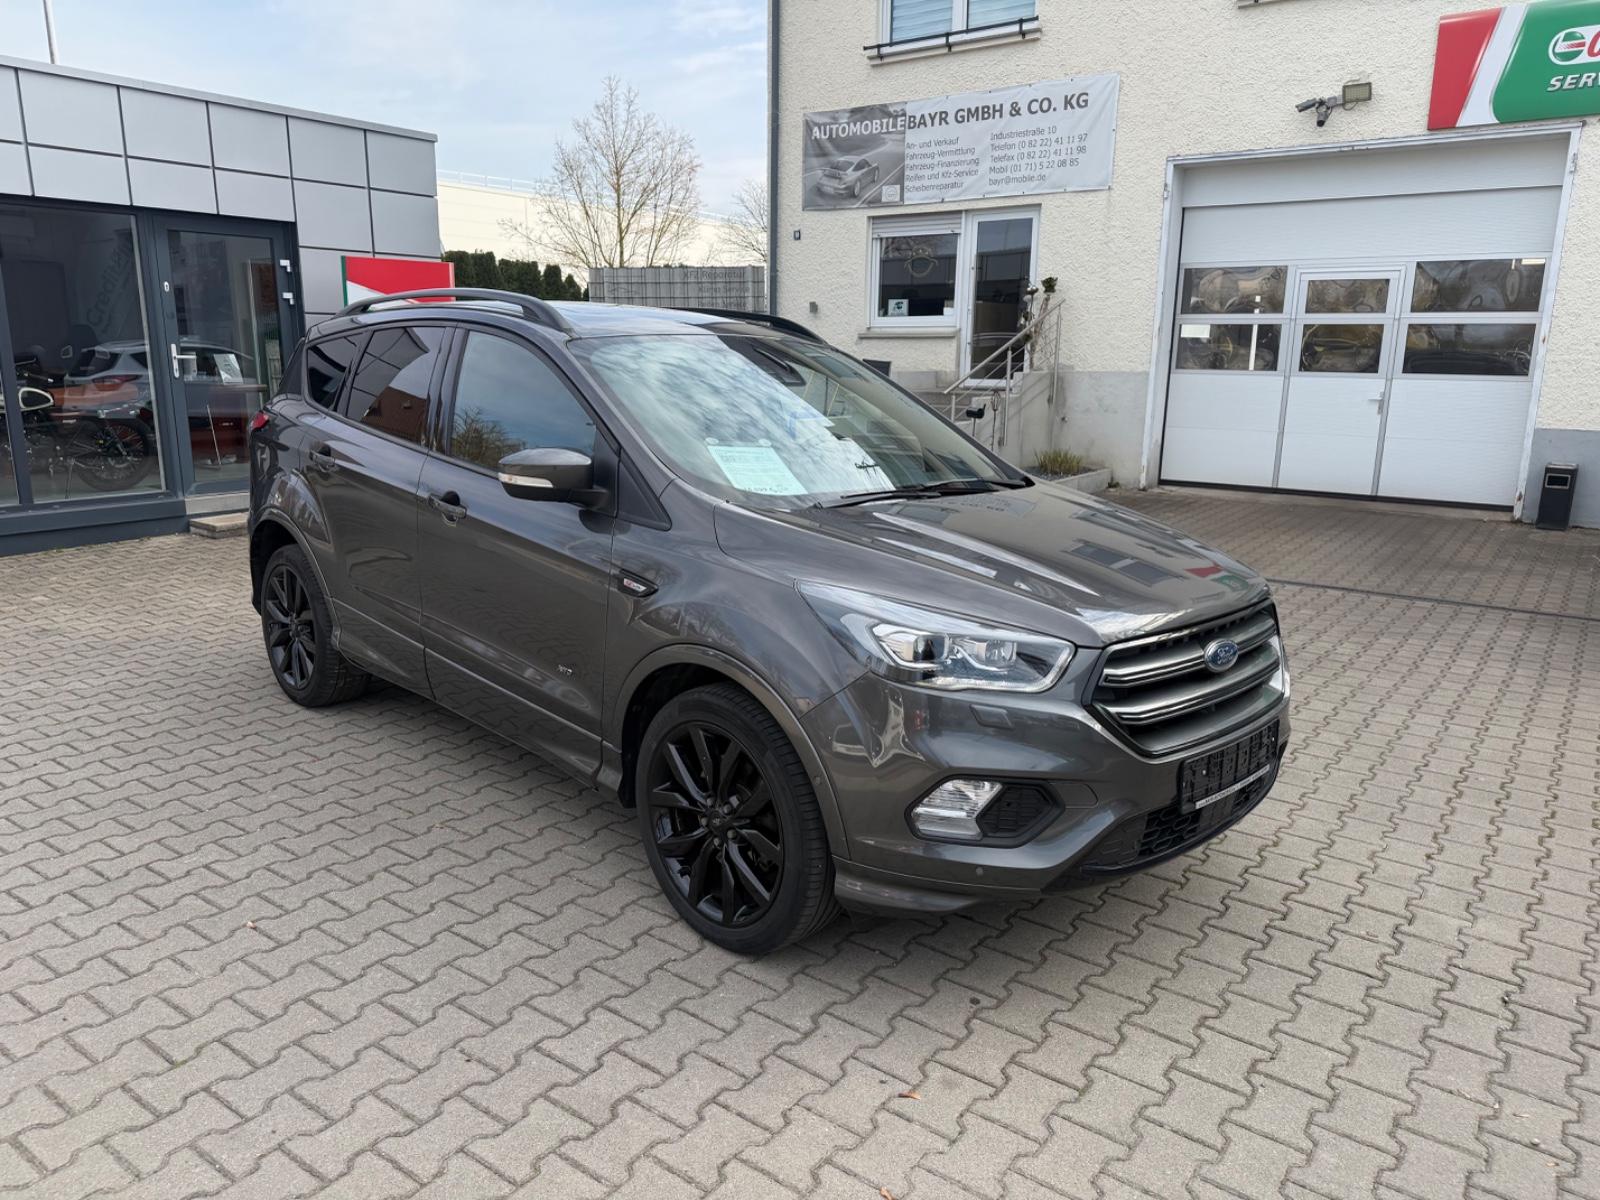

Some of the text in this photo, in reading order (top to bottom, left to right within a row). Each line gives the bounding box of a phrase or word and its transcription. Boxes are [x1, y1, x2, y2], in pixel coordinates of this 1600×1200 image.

[1546, 72, 1600, 91] SER
[812, 92, 1089, 139] AUTOMOBILE BAYR GMBH & CO. KG
[990, 128, 1045, 140] Industriestraße
[934, 136, 959, 146] Verkauf
[990, 142, 1016, 152] Telefon
[990, 154, 1014, 163] Telefax
[989, 166, 1008, 174] Mobil
